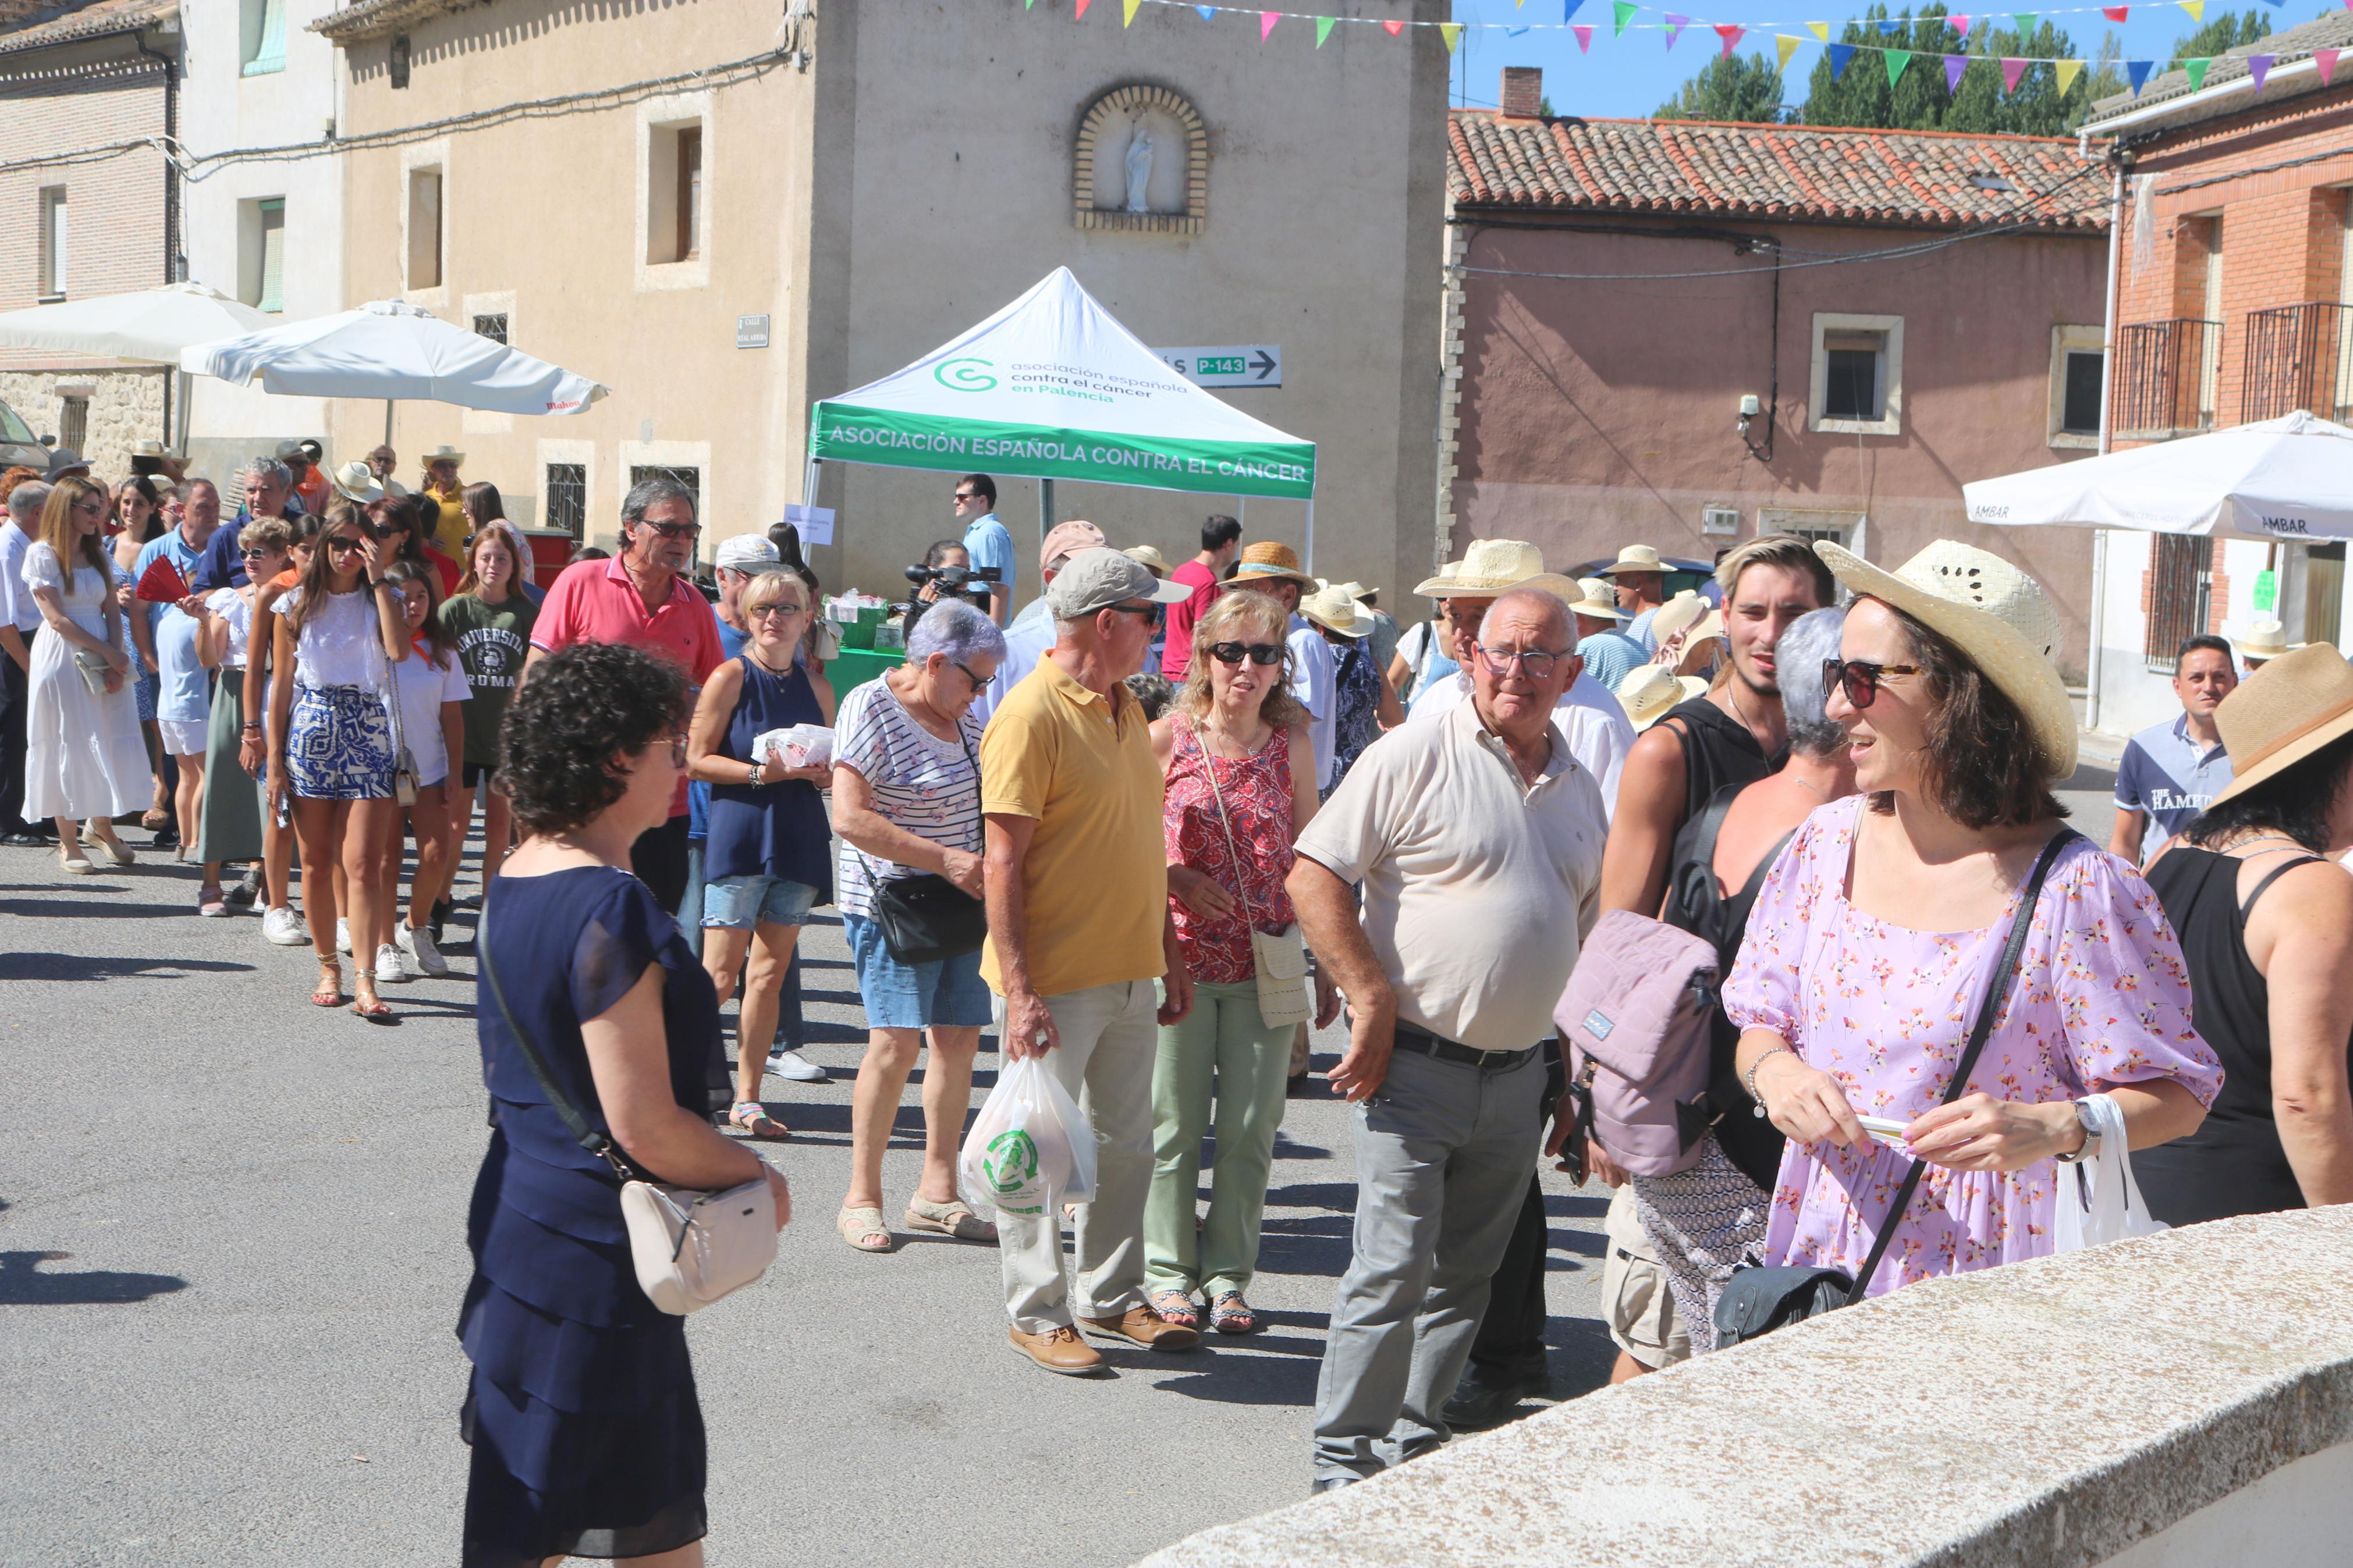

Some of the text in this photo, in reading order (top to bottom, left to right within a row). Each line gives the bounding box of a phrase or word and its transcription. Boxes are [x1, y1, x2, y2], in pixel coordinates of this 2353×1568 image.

[1199, 358, 1244, 373] P-143
[1012, 362, 1188, 394] asociación española
[1012, 373, 1153, 399] contra el cáncer
[1038, 385, 1115, 403] Palencia
[546, 400, 581, 410] Mahou
[829, 425, 1306, 482] ASOCIACIÓN ESPAÑOLA CONTRA EL CÁNCER
[1975, 505, 2010, 519] AMBAR
[2262, 515, 2309, 534] AMBAR
[466, 674, 516, 687] ROMA
[2151, 788, 2170, 798] THE
[2152, 794, 2213, 810] HAMPT
